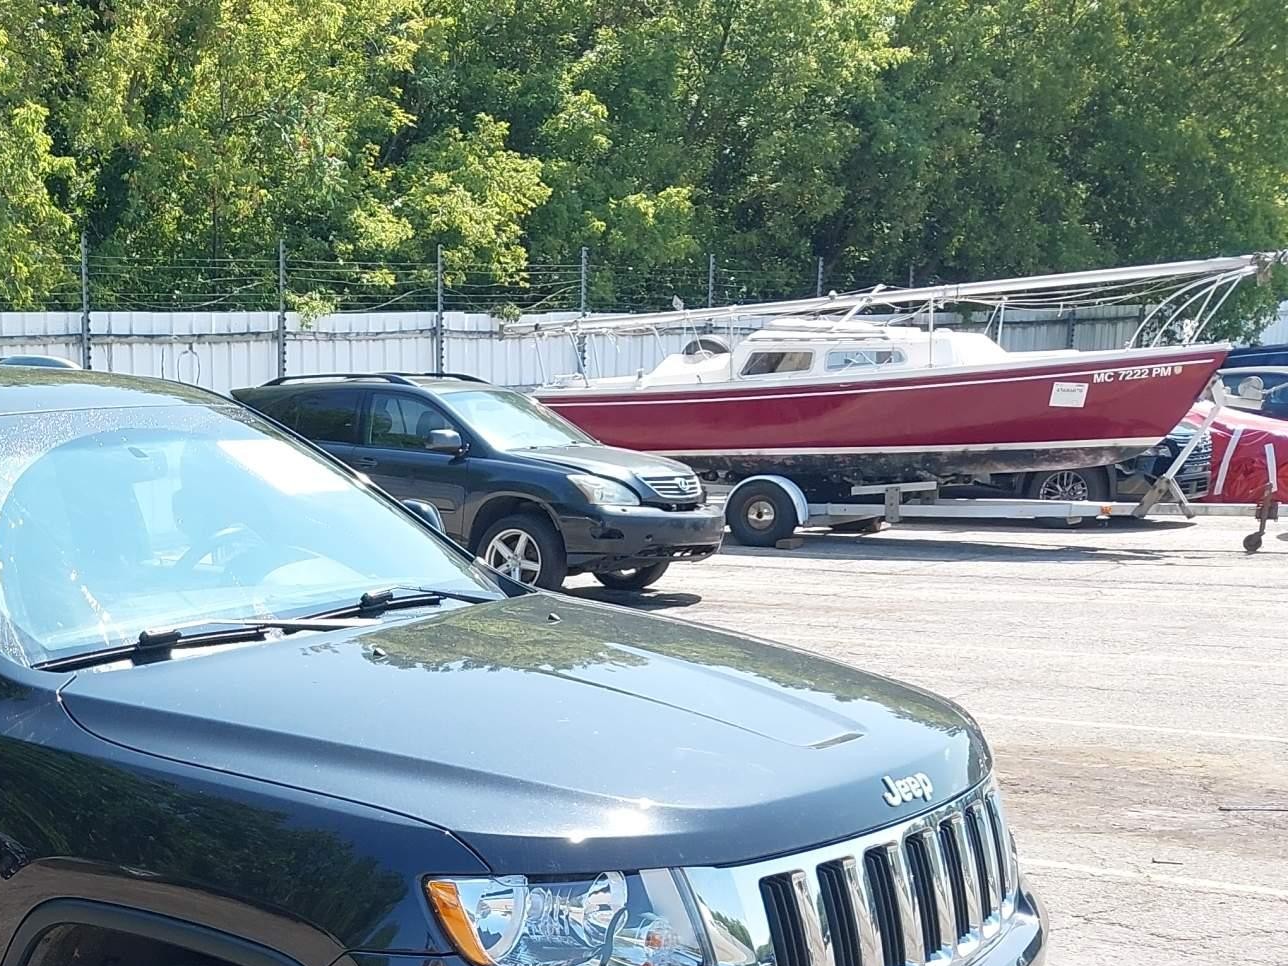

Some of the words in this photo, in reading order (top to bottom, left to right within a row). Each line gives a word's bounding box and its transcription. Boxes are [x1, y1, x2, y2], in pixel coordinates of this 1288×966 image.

[1093, 372, 1114, 383] MC
[1118, 368, 1149, 380] 7222
[1152, 366, 1172, 378] PM
[881, 772, 933, 806] Jeep
